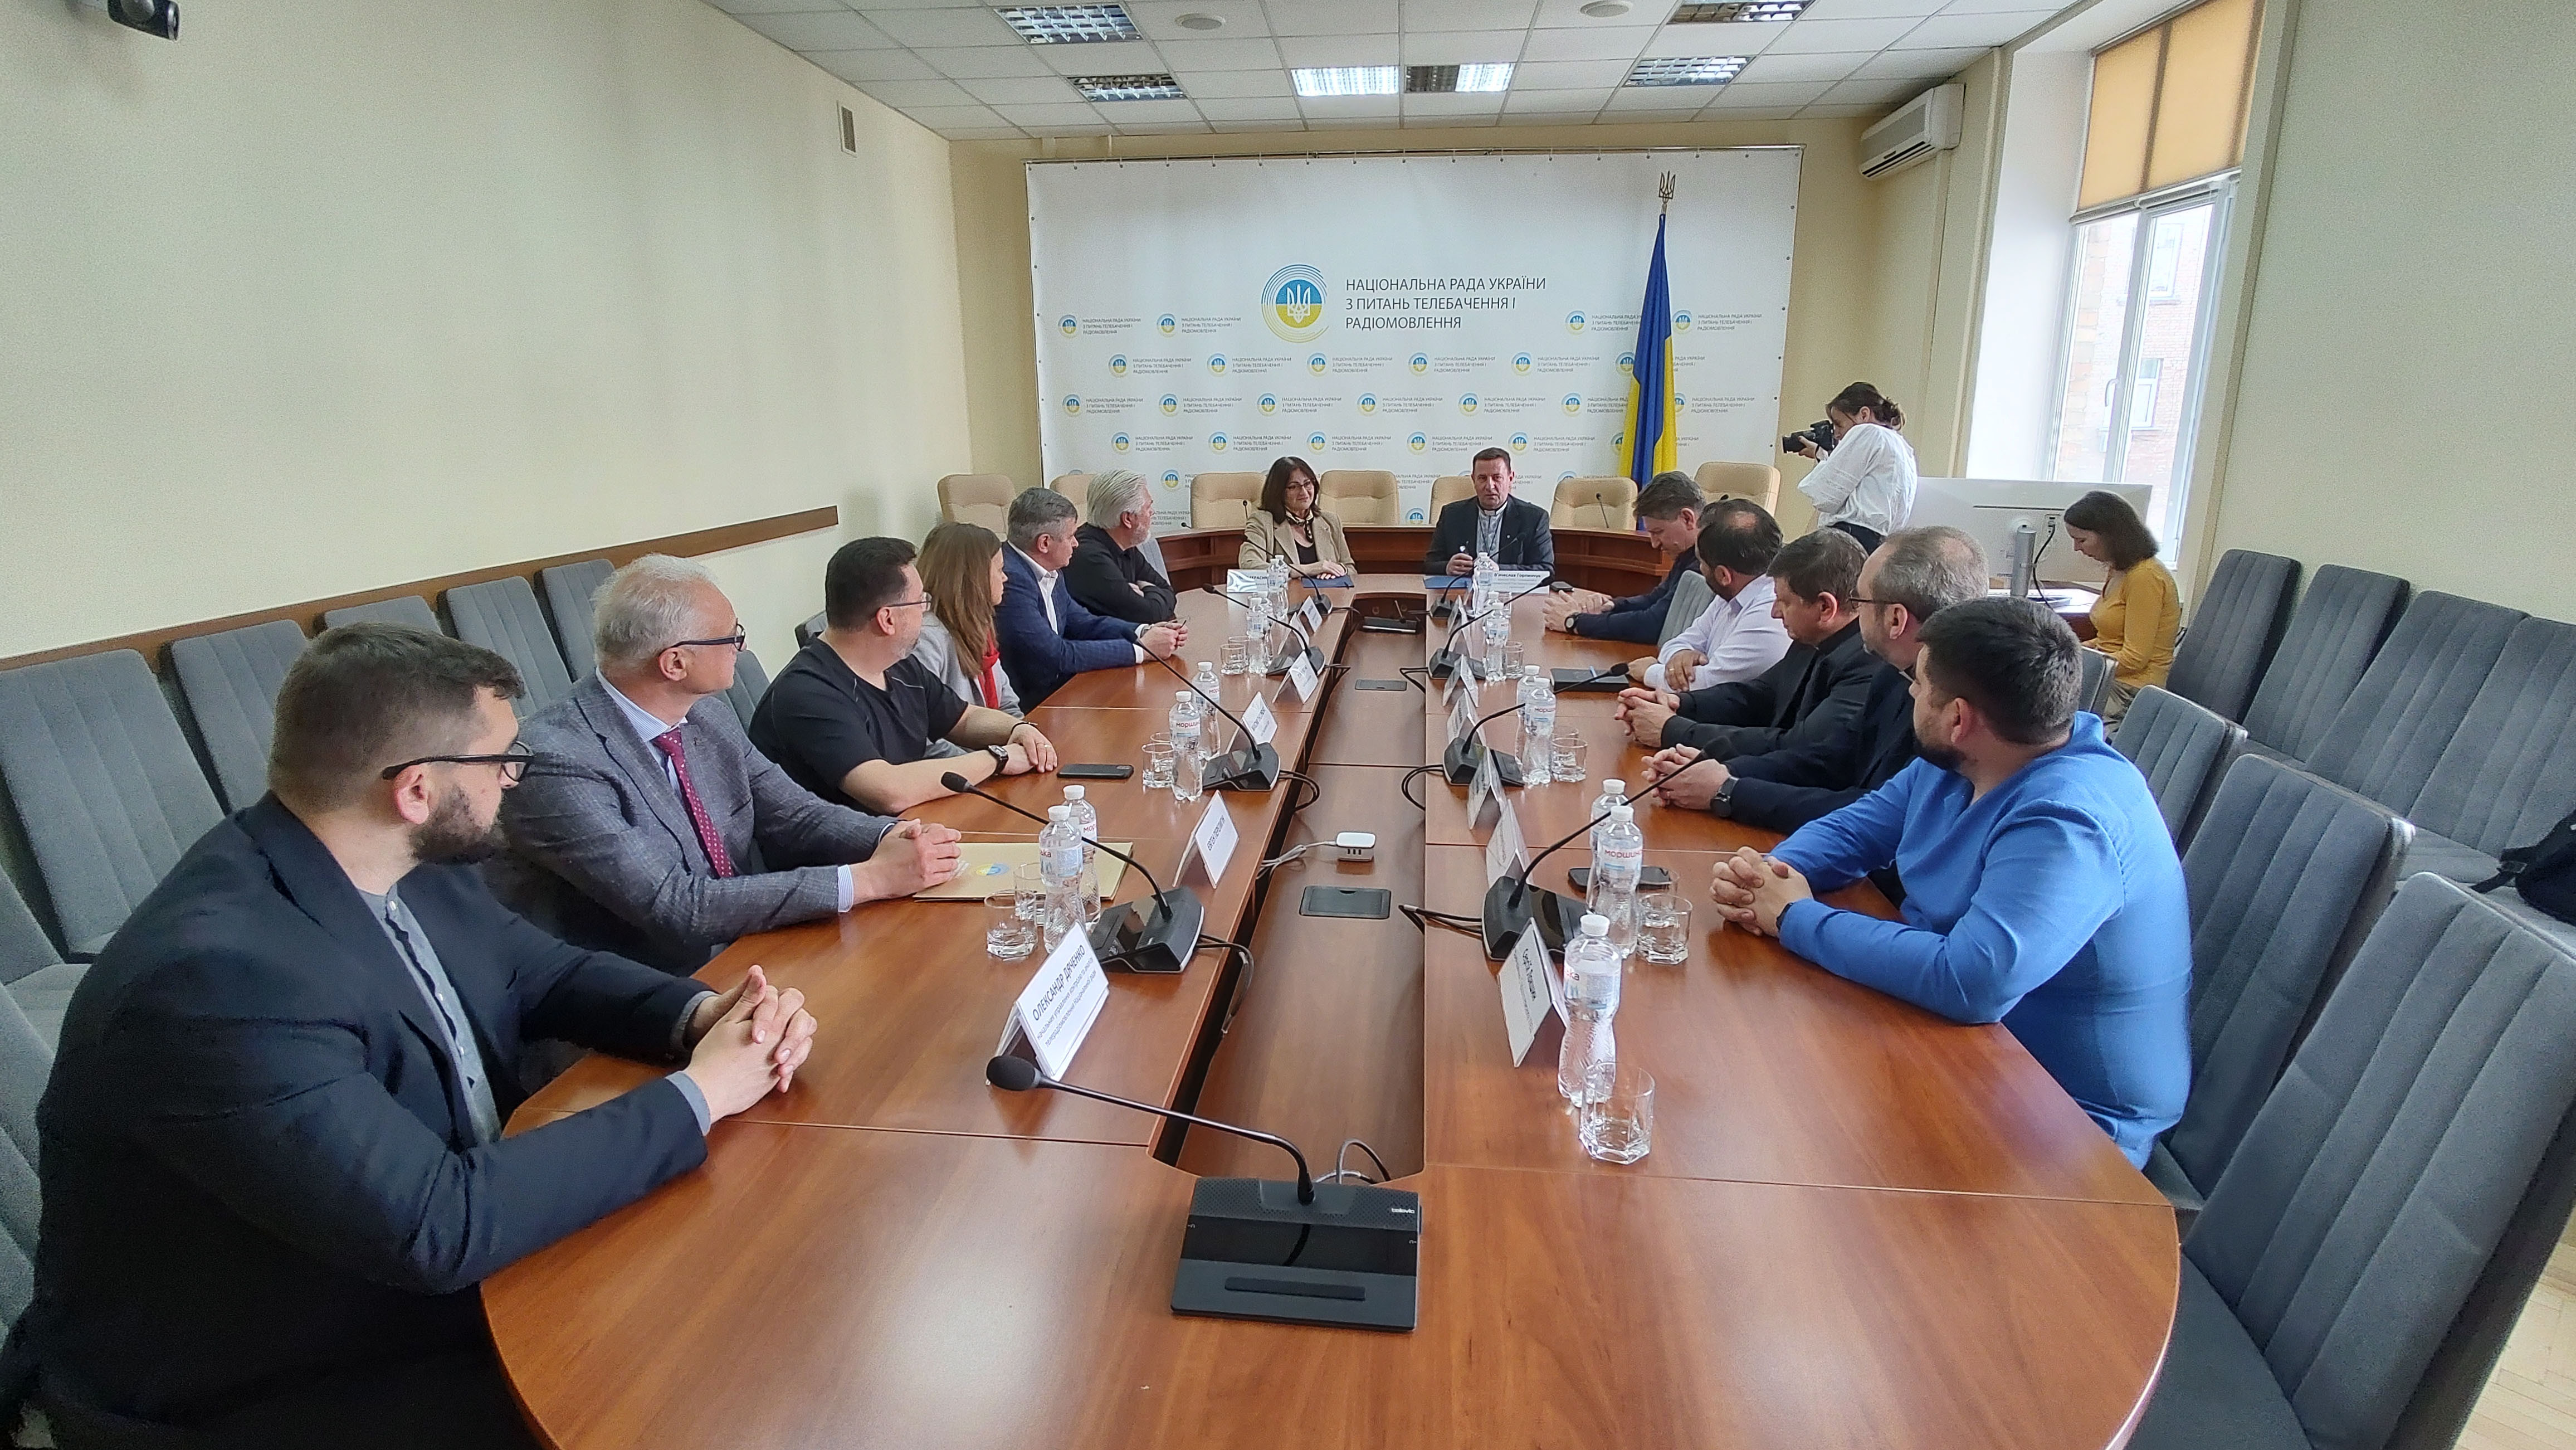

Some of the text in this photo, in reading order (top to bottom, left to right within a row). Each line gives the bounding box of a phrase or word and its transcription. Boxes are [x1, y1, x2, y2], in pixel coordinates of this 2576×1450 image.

[1346, 275, 1545, 293] НАЦІОНАЛЬНА РАДА УКРАЇНИ
[1345, 297, 1515, 310] З ПИТАНЬ ТЕЛЕБАЧЕННЯ І
[1346, 317, 1461, 331] РАДІОМОВЛЕННЯ
[1033, 945, 1085, 1021] ОЛЕКСАНДР ДЯЧЕНКО
